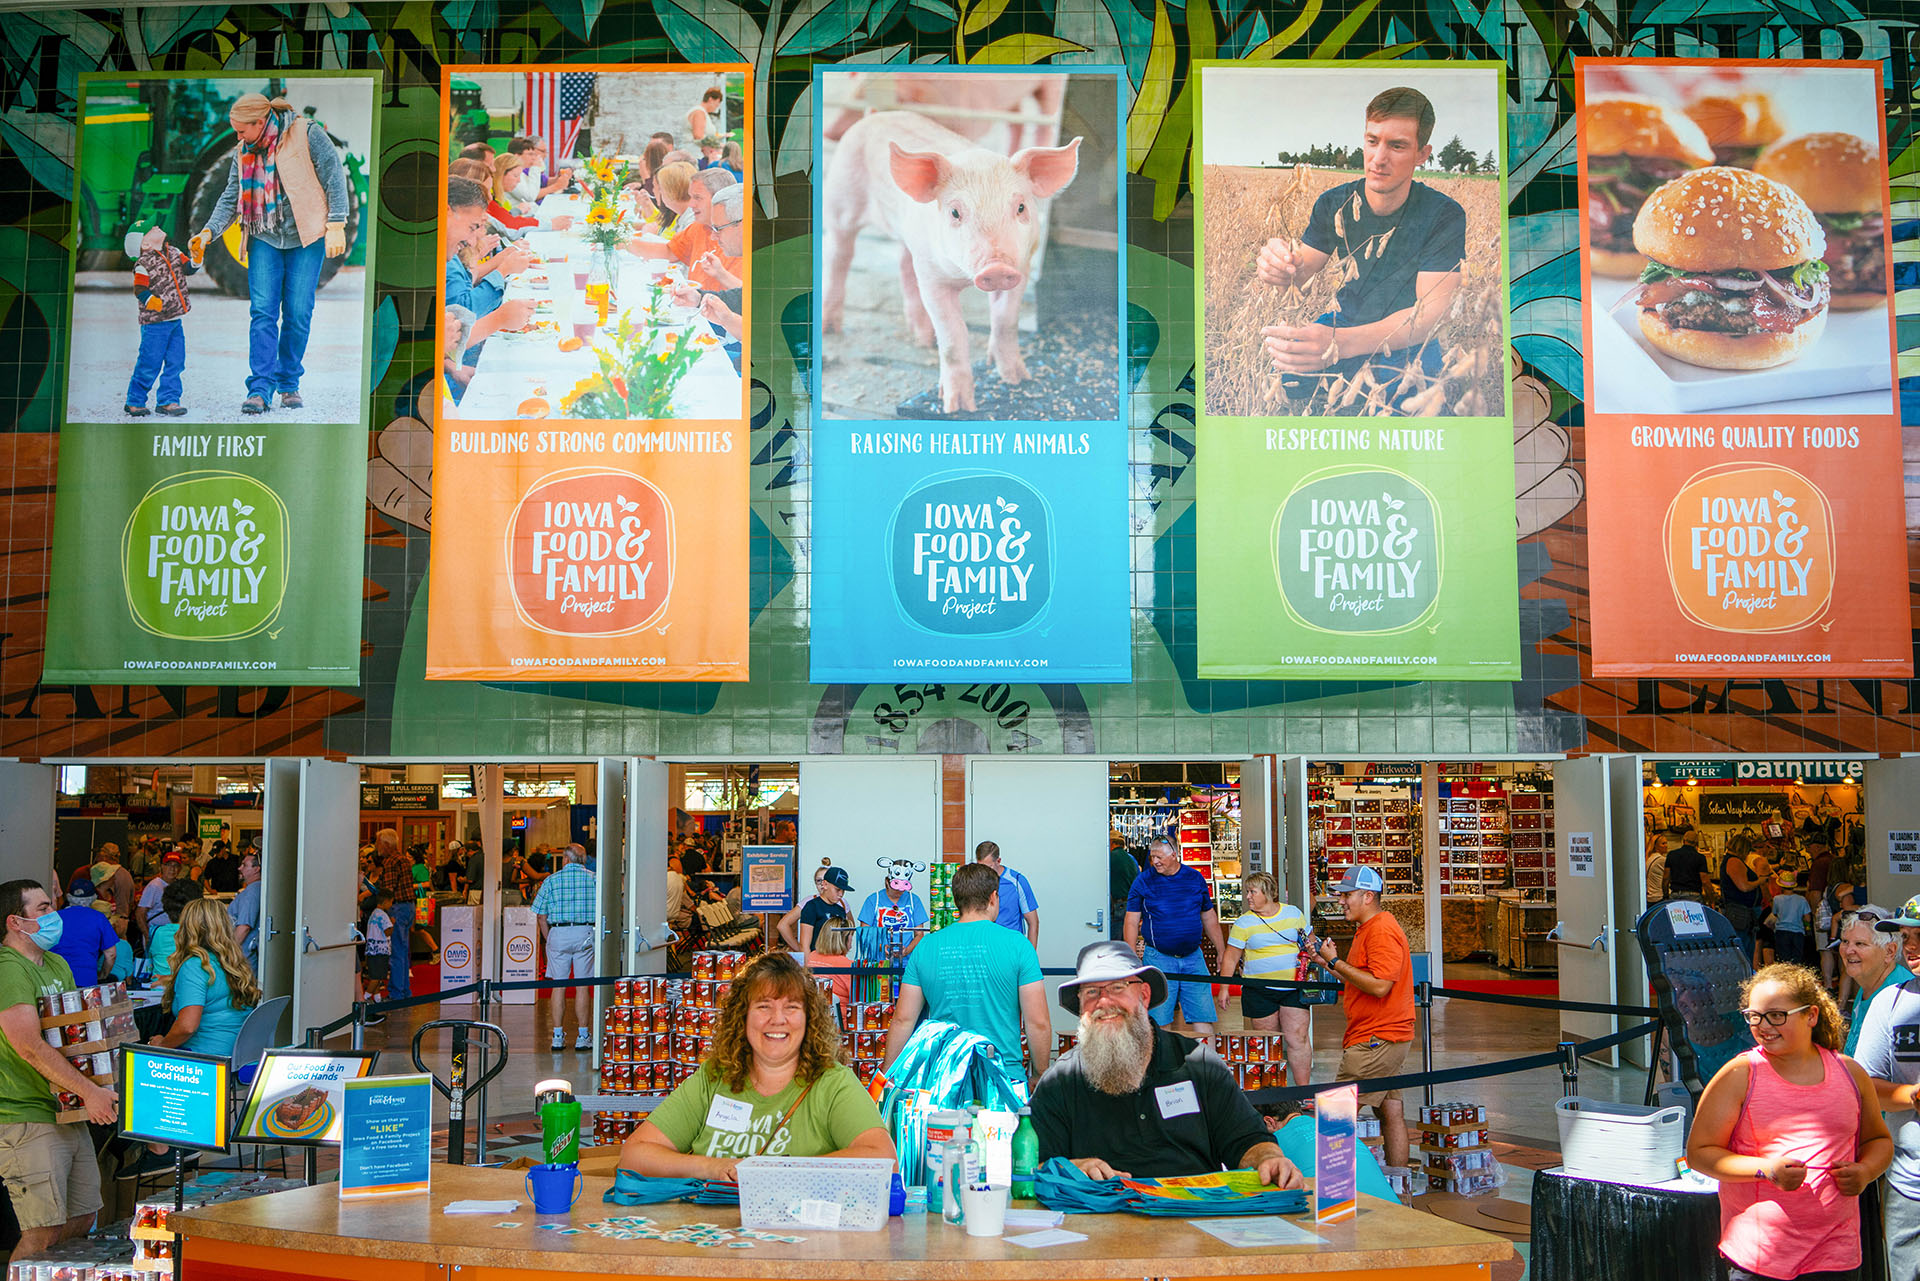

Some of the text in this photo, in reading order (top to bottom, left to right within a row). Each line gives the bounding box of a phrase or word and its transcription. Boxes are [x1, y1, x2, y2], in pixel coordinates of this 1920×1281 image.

[152, 435, 267, 457] FAMILY FIRST
[450, 431, 733, 454] BUILDING STRONG COMMUNITIES
[851, 433, 1090, 455] RAISING HEALTHY ANIMALS
[1266, 428, 1445, 451] RESPECTING NATURE
[1631, 426, 1860, 451] GROWING QUALITY FOODS
[161, 505, 230, 532] IOWA
[544, 501, 615, 529] IOWA
[925, 503, 995, 529] IOWA
[1311, 499, 1381, 526] IOWA
[1702, 497, 1772, 524] IOWA
[230, 519, 265, 565] &
[616, 515, 651, 562] &
[996, 517, 1032, 563] &
[1383, 513, 1418, 560] &
[1774, 511, 1809, 558] &
[160, 561, 267, 604] FAMILY
[546, 558, 653, 601] FAMILY
[927, 560, 1034, 602] FAMILY
[1315, 556, 1422, 599] FAMILY
[1706, 553, 1814, 597] FAMILY
[173, 598, 229, 621] Project
[560, 595, 617, 618] Project
[942, 596, 997, 619] Project
[1329, 592, 1385, 617] Project
[1722, 590, 1777, 615] Project
[123, 661, 277, 670] IOWAFOODANDFAMILY.COM
[510, 656, 666, 666] IOWAFOODANDFAMILY.COM
[893, 658, 1049, 668] IOWAFOODANDFAMILY.COM
[1280, 656, 1438, 665] IOWAFOODANDFAMILY.COM
[1675, 653, 1832, 663] IOWAFOODANDFAMILY.COM
[447, 950, 468, 958] DAVIS
[510, 944, 531, 952] DAVIS
[147, 1060, 203, 1076] Our Food is in
[151, 1069, 199, 1084] Good Hands
[287, 1072, 338, 1081] Good Hands
[304, 1063, 325, 1072] Food
[327, 1063, 334, 1072] is
[336, 1063, 344, 1072] in
[766, 1127, 792, 1155] &
